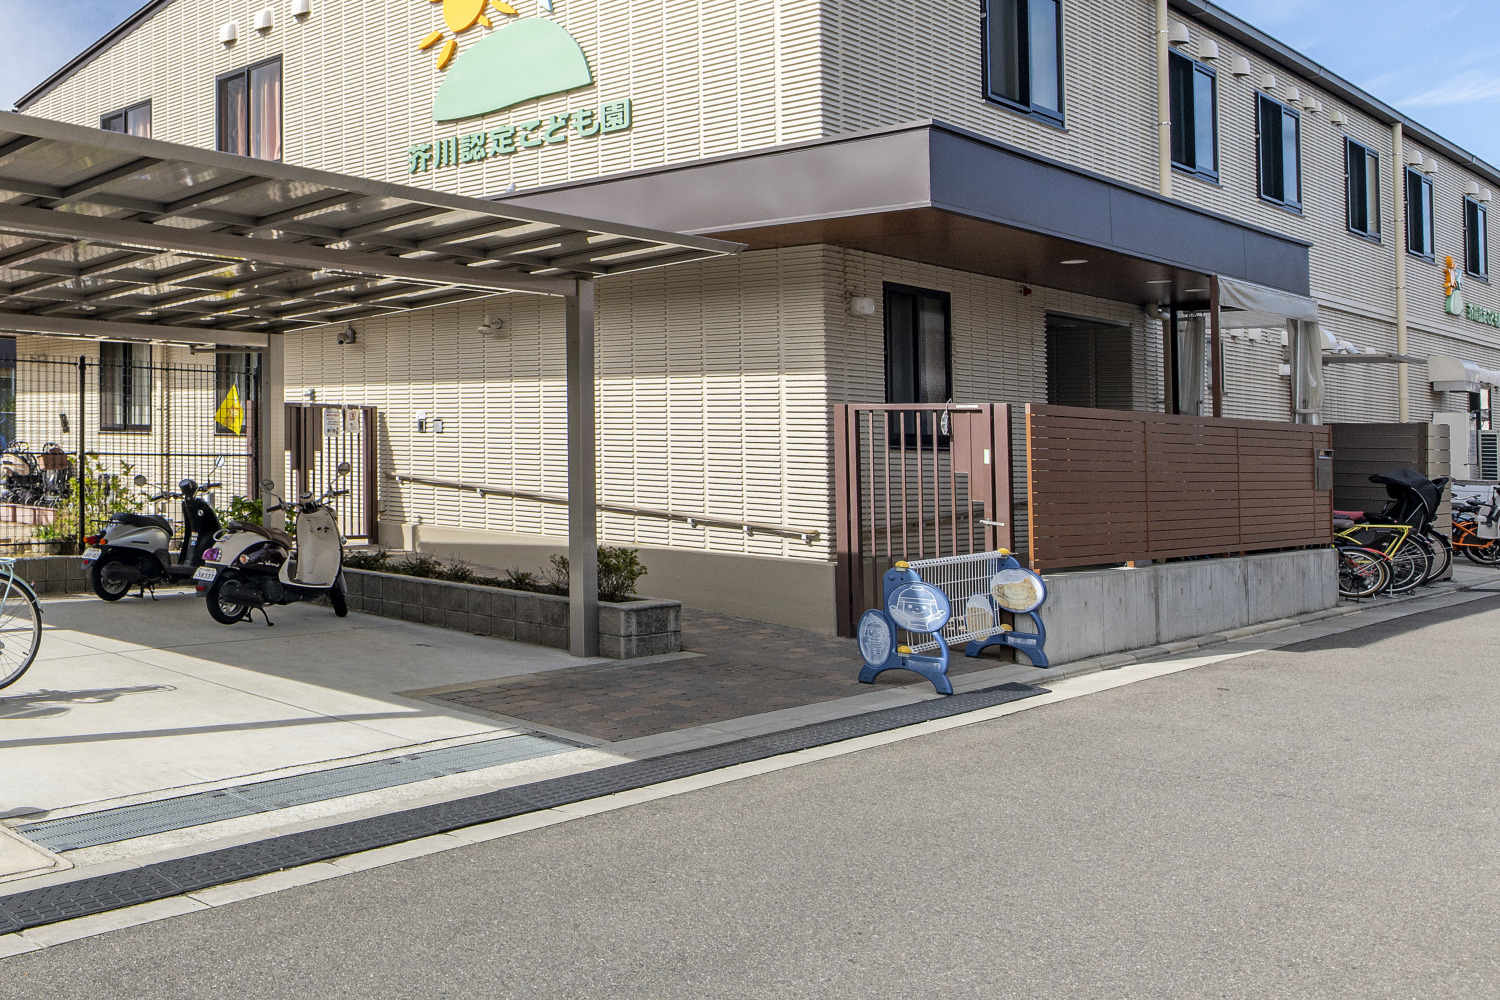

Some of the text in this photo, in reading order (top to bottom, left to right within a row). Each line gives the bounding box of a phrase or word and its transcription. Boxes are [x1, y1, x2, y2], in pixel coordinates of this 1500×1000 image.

[407, 98, 632, 173] 芥川認定こども園
